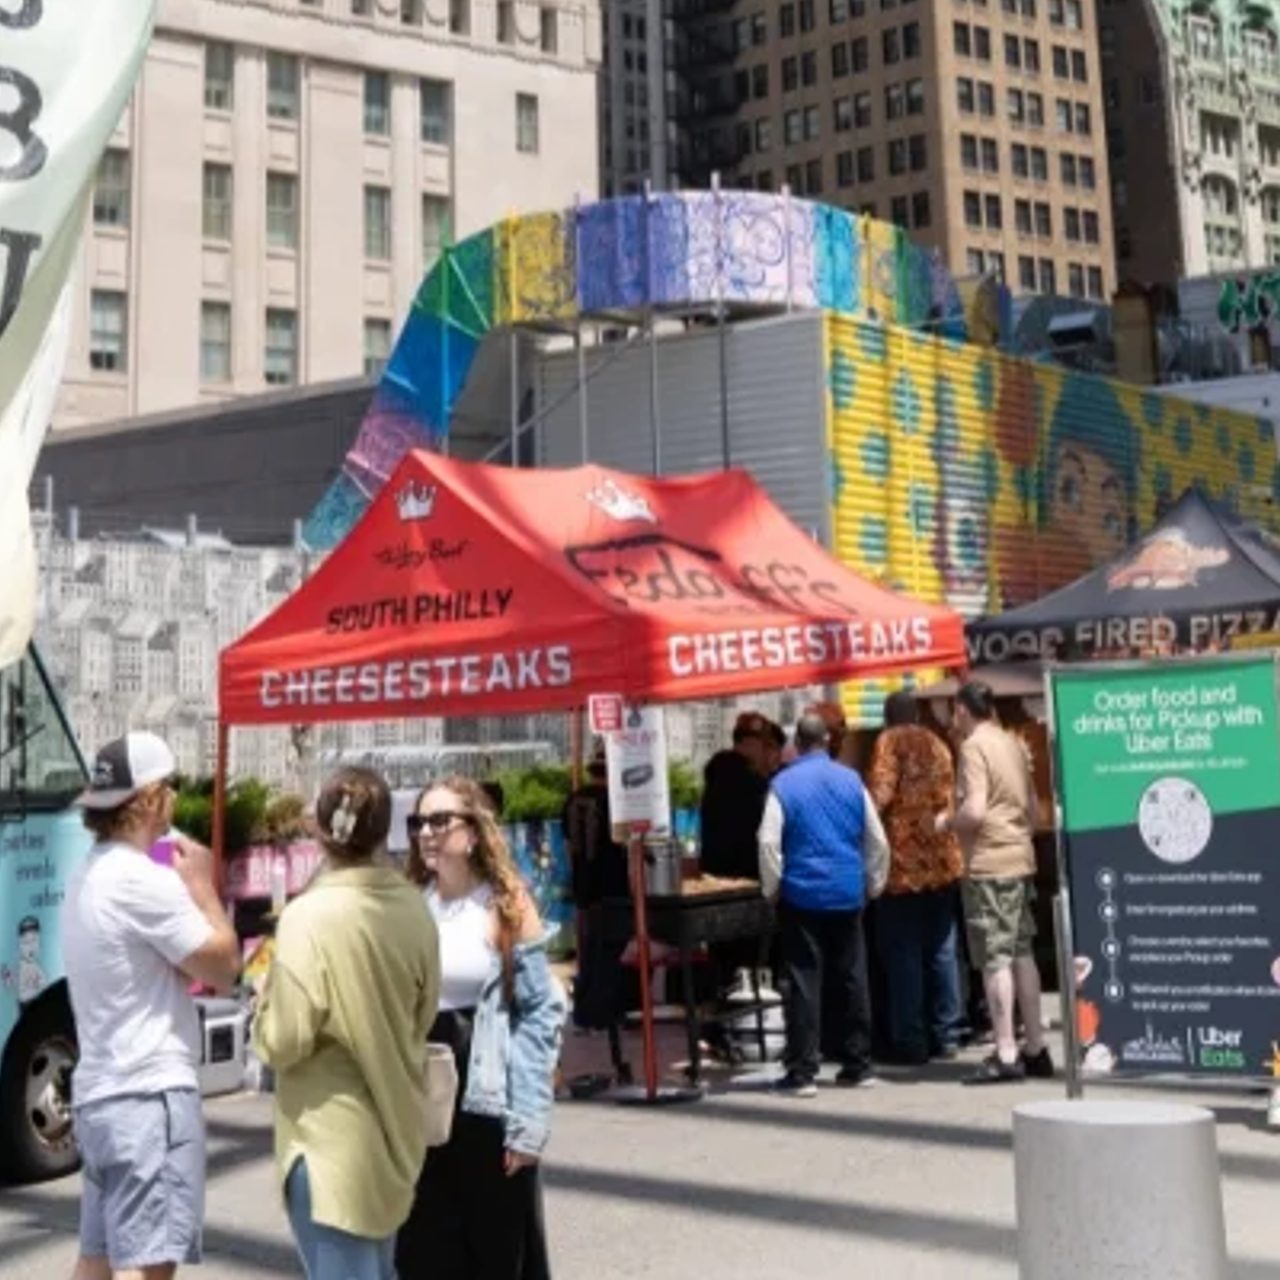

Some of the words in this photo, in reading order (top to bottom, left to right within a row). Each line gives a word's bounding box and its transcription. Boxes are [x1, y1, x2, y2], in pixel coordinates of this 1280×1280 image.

[326, 596, 407, 635] SOUTH
[414, 587, 514, 625] PHILLY
[668, 617, 933, 676] CHEESESTEAKS
[1075, 617, 1177, 649] FIRED
[260, 645, 572, 707] CHEESESTEAKS
[1093, 689, 1147, 712] Order
[1151, 685, 1198, 707] food
[1200, 683, 1237, 705] and
[1073, 713, 1126, 734] drinks
[1129, 711, 1153, 731] for
[1157, 709, 1220, 731] Pickup
[1222, 706, 1264, 726] with
[1126, 733, 1169, 754] Uber
[1173, 731, 1213, 752] Eats
[1197, 1026, 1243, 1047] Uber
[1200, 1045, 1245, 1067] Eats
